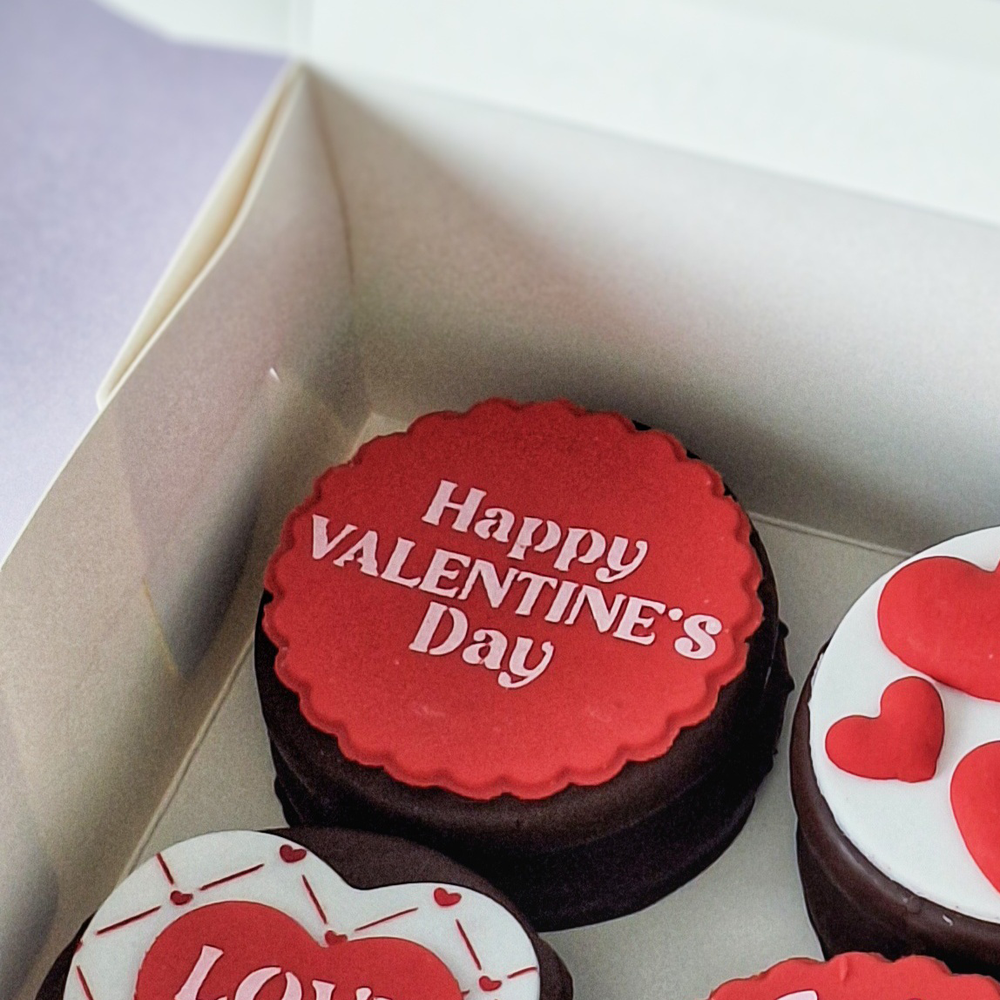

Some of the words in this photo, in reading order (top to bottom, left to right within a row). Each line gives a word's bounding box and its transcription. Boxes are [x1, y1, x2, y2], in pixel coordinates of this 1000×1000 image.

[422, 479, 648, 583] Happy
[311, 514, 722, 660] VALENTINE'S
[409, 601, 554, 688] Day
